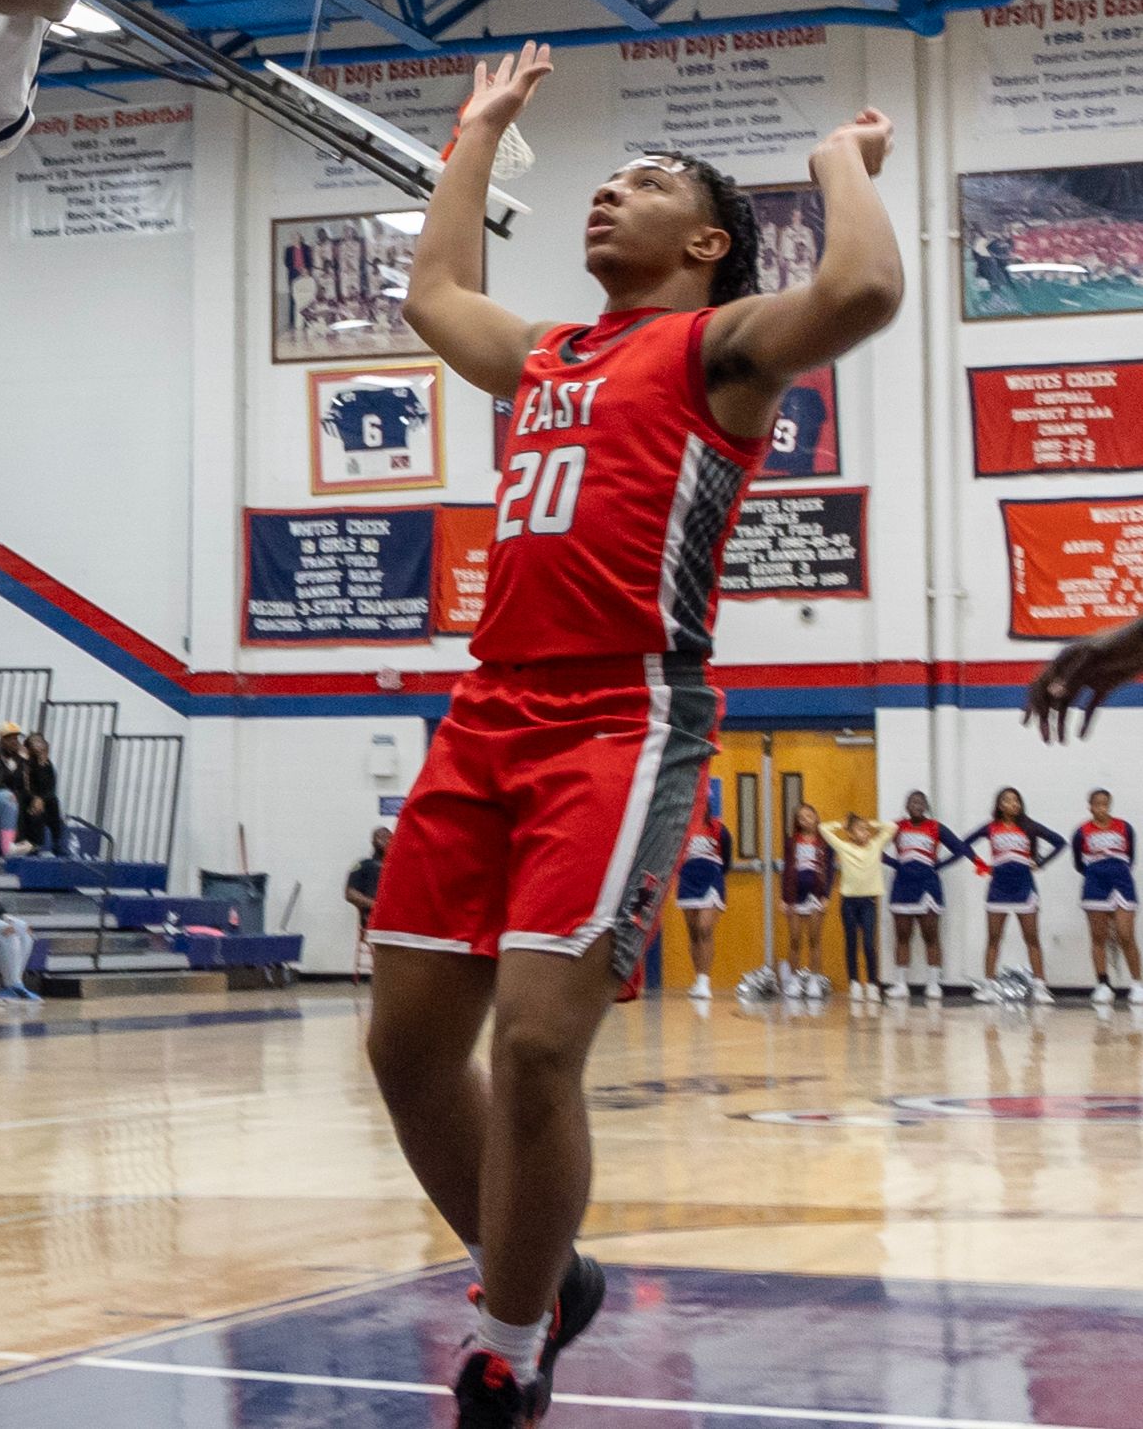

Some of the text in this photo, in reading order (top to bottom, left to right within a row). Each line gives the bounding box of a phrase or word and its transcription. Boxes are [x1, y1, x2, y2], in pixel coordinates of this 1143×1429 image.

[1004, 370, 1118, 391] WHITES CREEK
[516, 376, 607, 437] EAST
[362, 414, 383, 448] 6
[495, 444, 586, 544] 20
[287, 519, 391, 537] WHITES CREEK
[318, 536, 357, 552] GIRLS
[356, 597, 429, 615] CHAMPIONS
